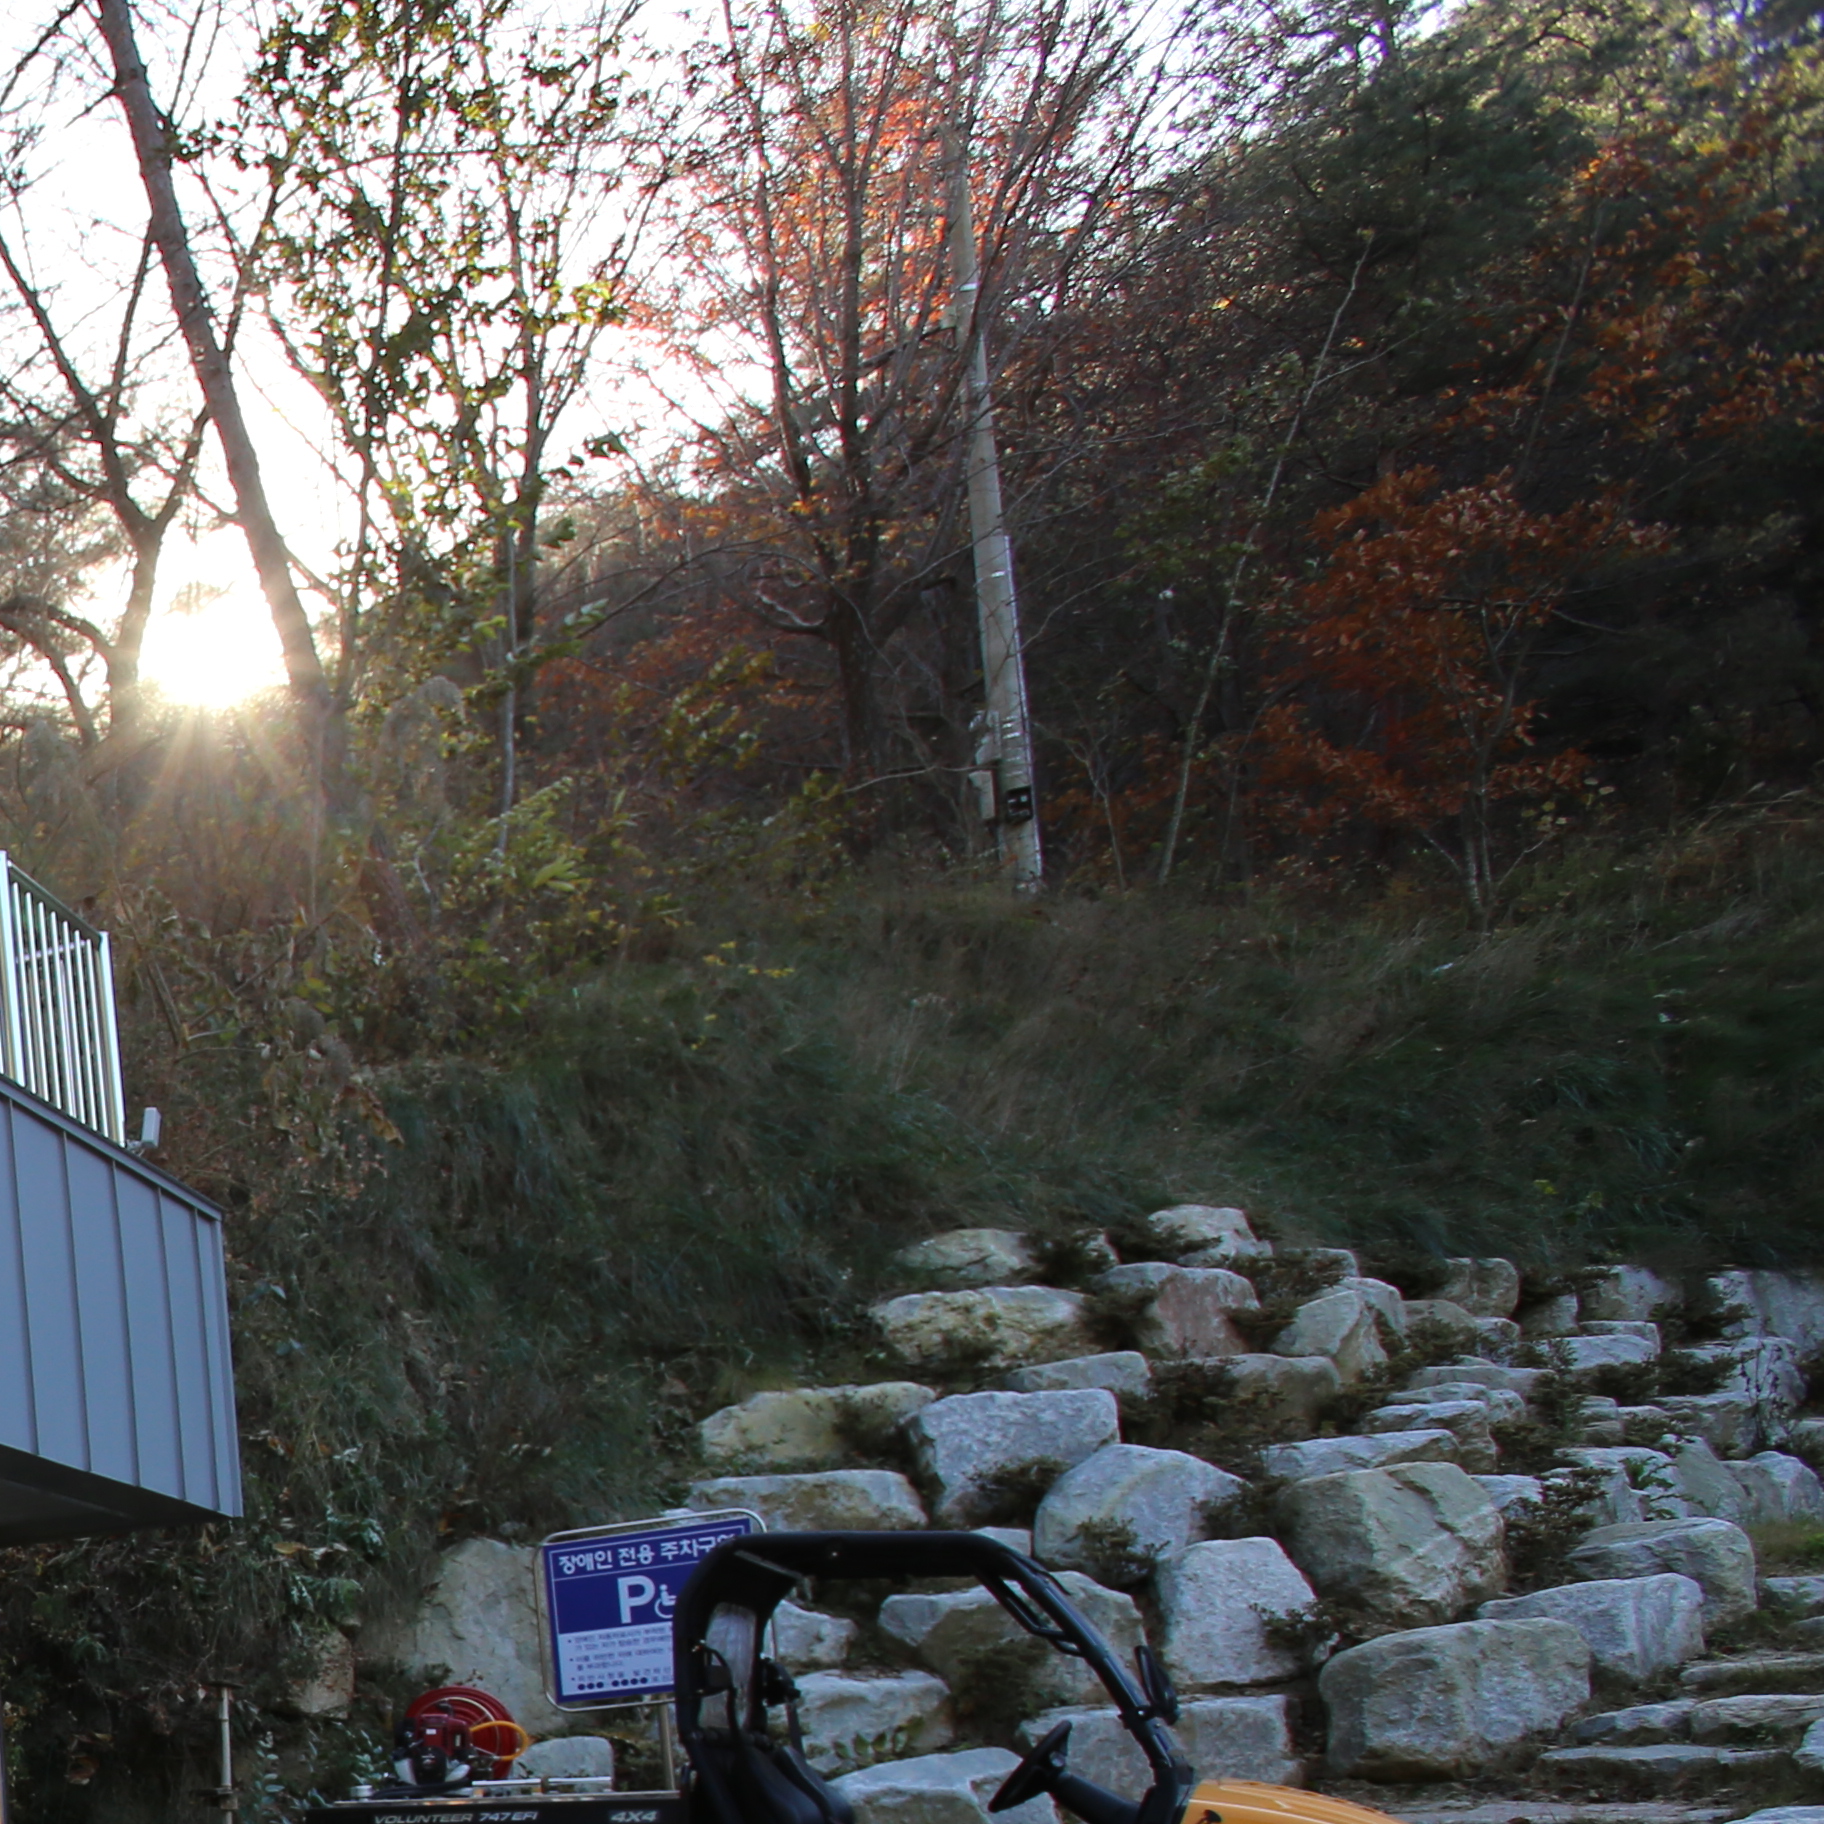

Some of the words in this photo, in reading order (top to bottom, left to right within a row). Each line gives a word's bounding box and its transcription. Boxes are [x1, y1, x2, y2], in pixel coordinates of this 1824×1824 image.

[558, 1550, 613, 1575] 장애인
[618, 1544, 655, 1567] 전용
[617, 1575, 656, 1624] P
[374, 1813, 474, 1824] VOLUNTEER
[610, 1810, 658, 1823] 4X4
